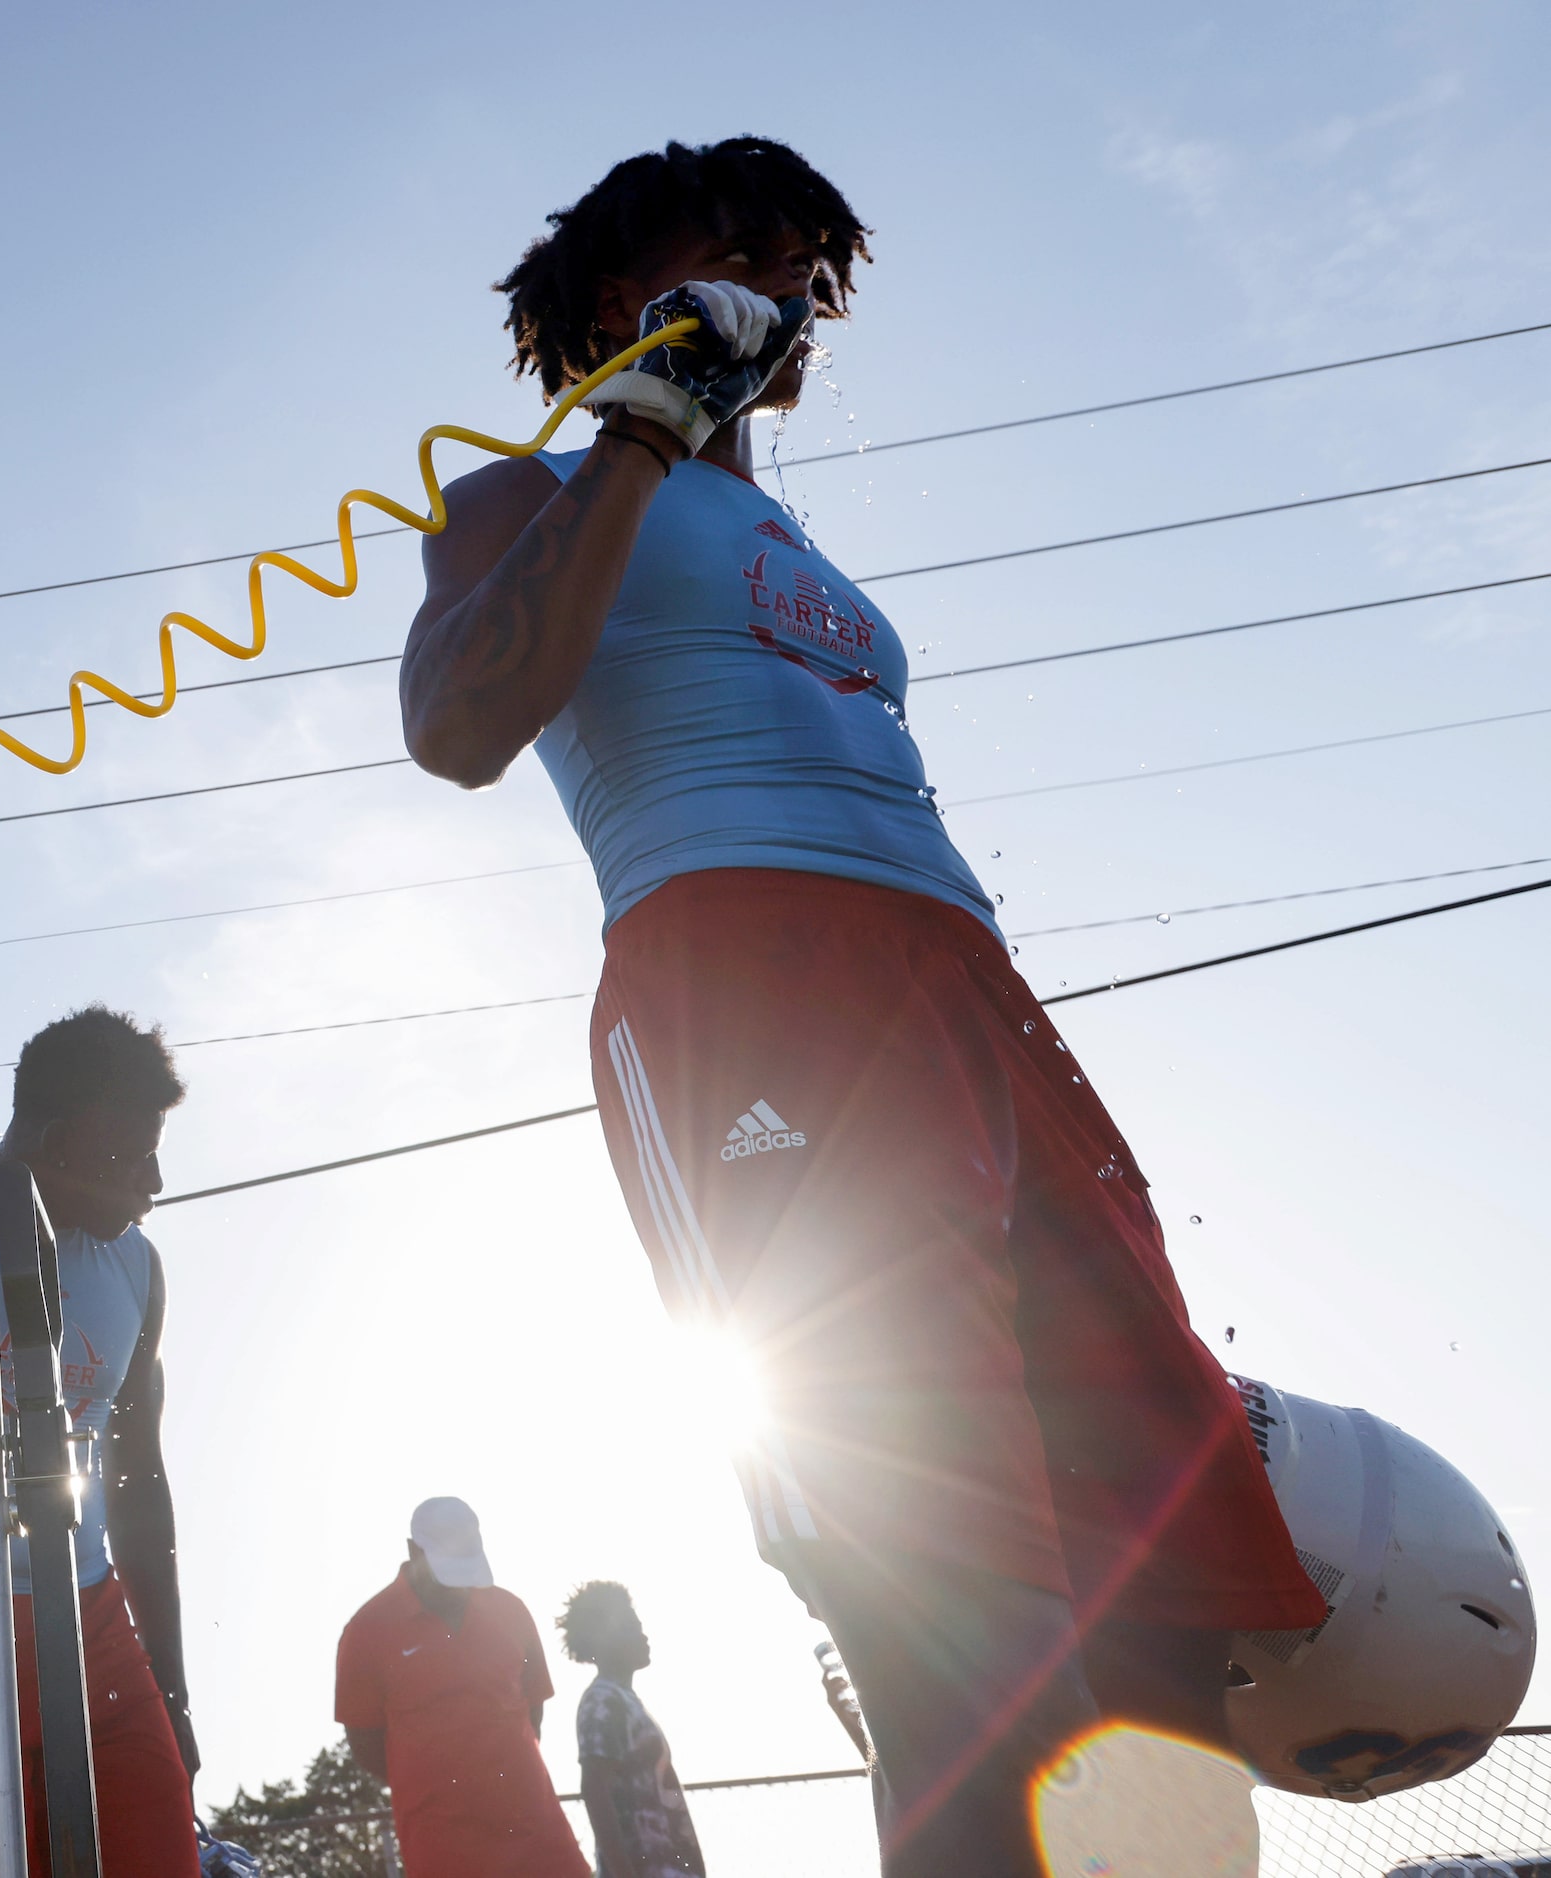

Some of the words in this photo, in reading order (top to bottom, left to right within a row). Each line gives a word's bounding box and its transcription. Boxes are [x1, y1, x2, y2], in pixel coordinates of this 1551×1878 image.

[750, 582, 874, 653] CARTER
[776, 615, 858, 660] FOOTBALL
[720, 1130, 807, 1162] adidas
